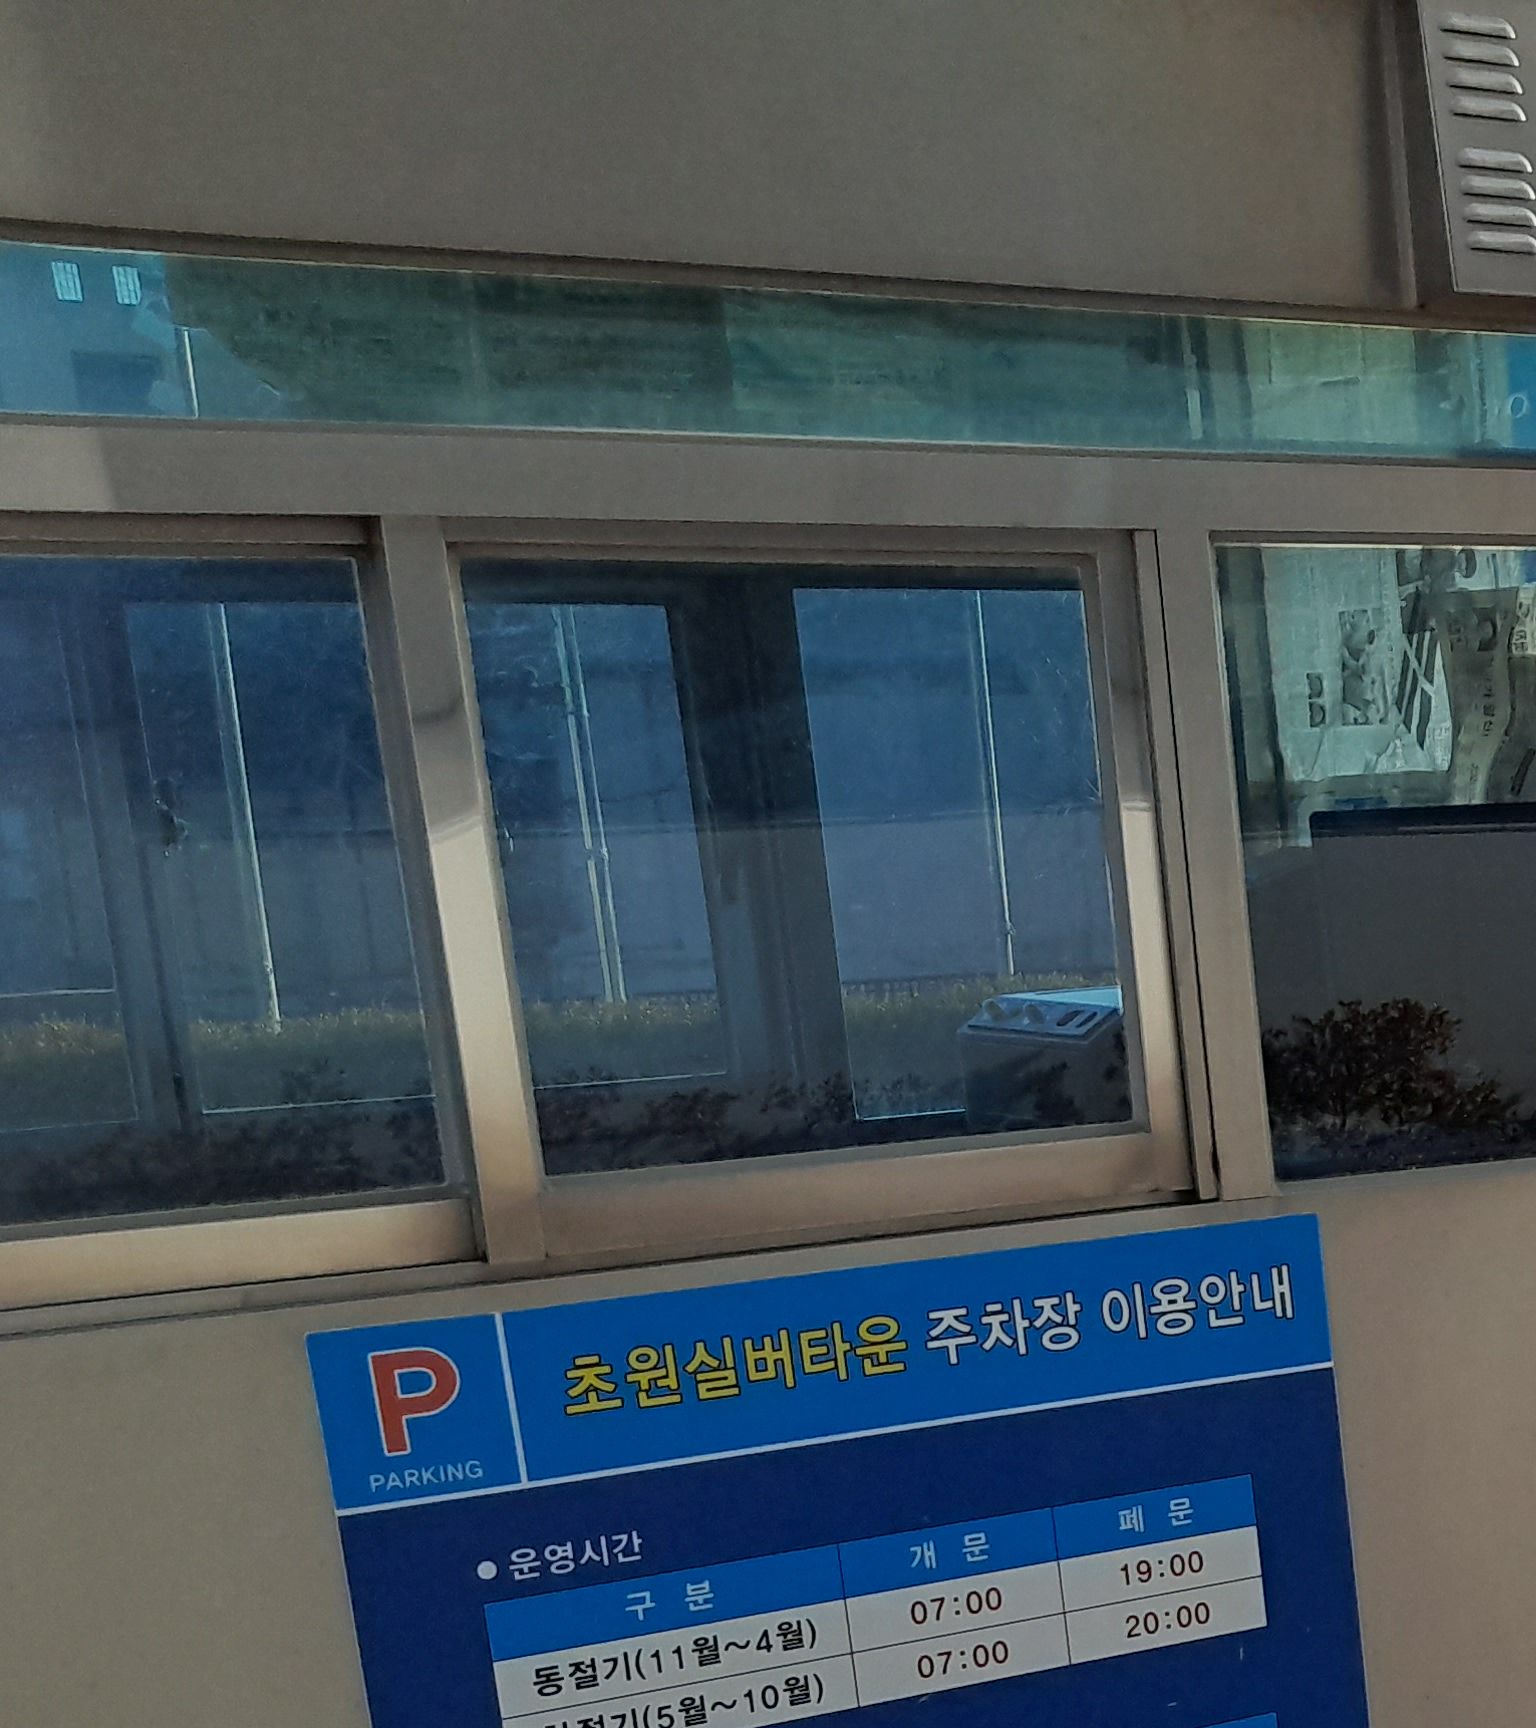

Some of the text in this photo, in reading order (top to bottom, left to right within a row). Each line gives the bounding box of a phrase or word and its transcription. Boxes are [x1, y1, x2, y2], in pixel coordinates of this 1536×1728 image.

[563, 1263, 1295, 1416] 초원실버타운 주차장 이용안내
[369, 1460, 483, 1492] PARKING
[509, 1530, 642, 1580] 운영시간
[910, 1586, 1002, 1625] 07:00
[1119, 1550, 1204, 1586] 19:00
[917, 1640, 1009, 1679] 07:00
[1125, 1601, 1210, 1639] 20:00
